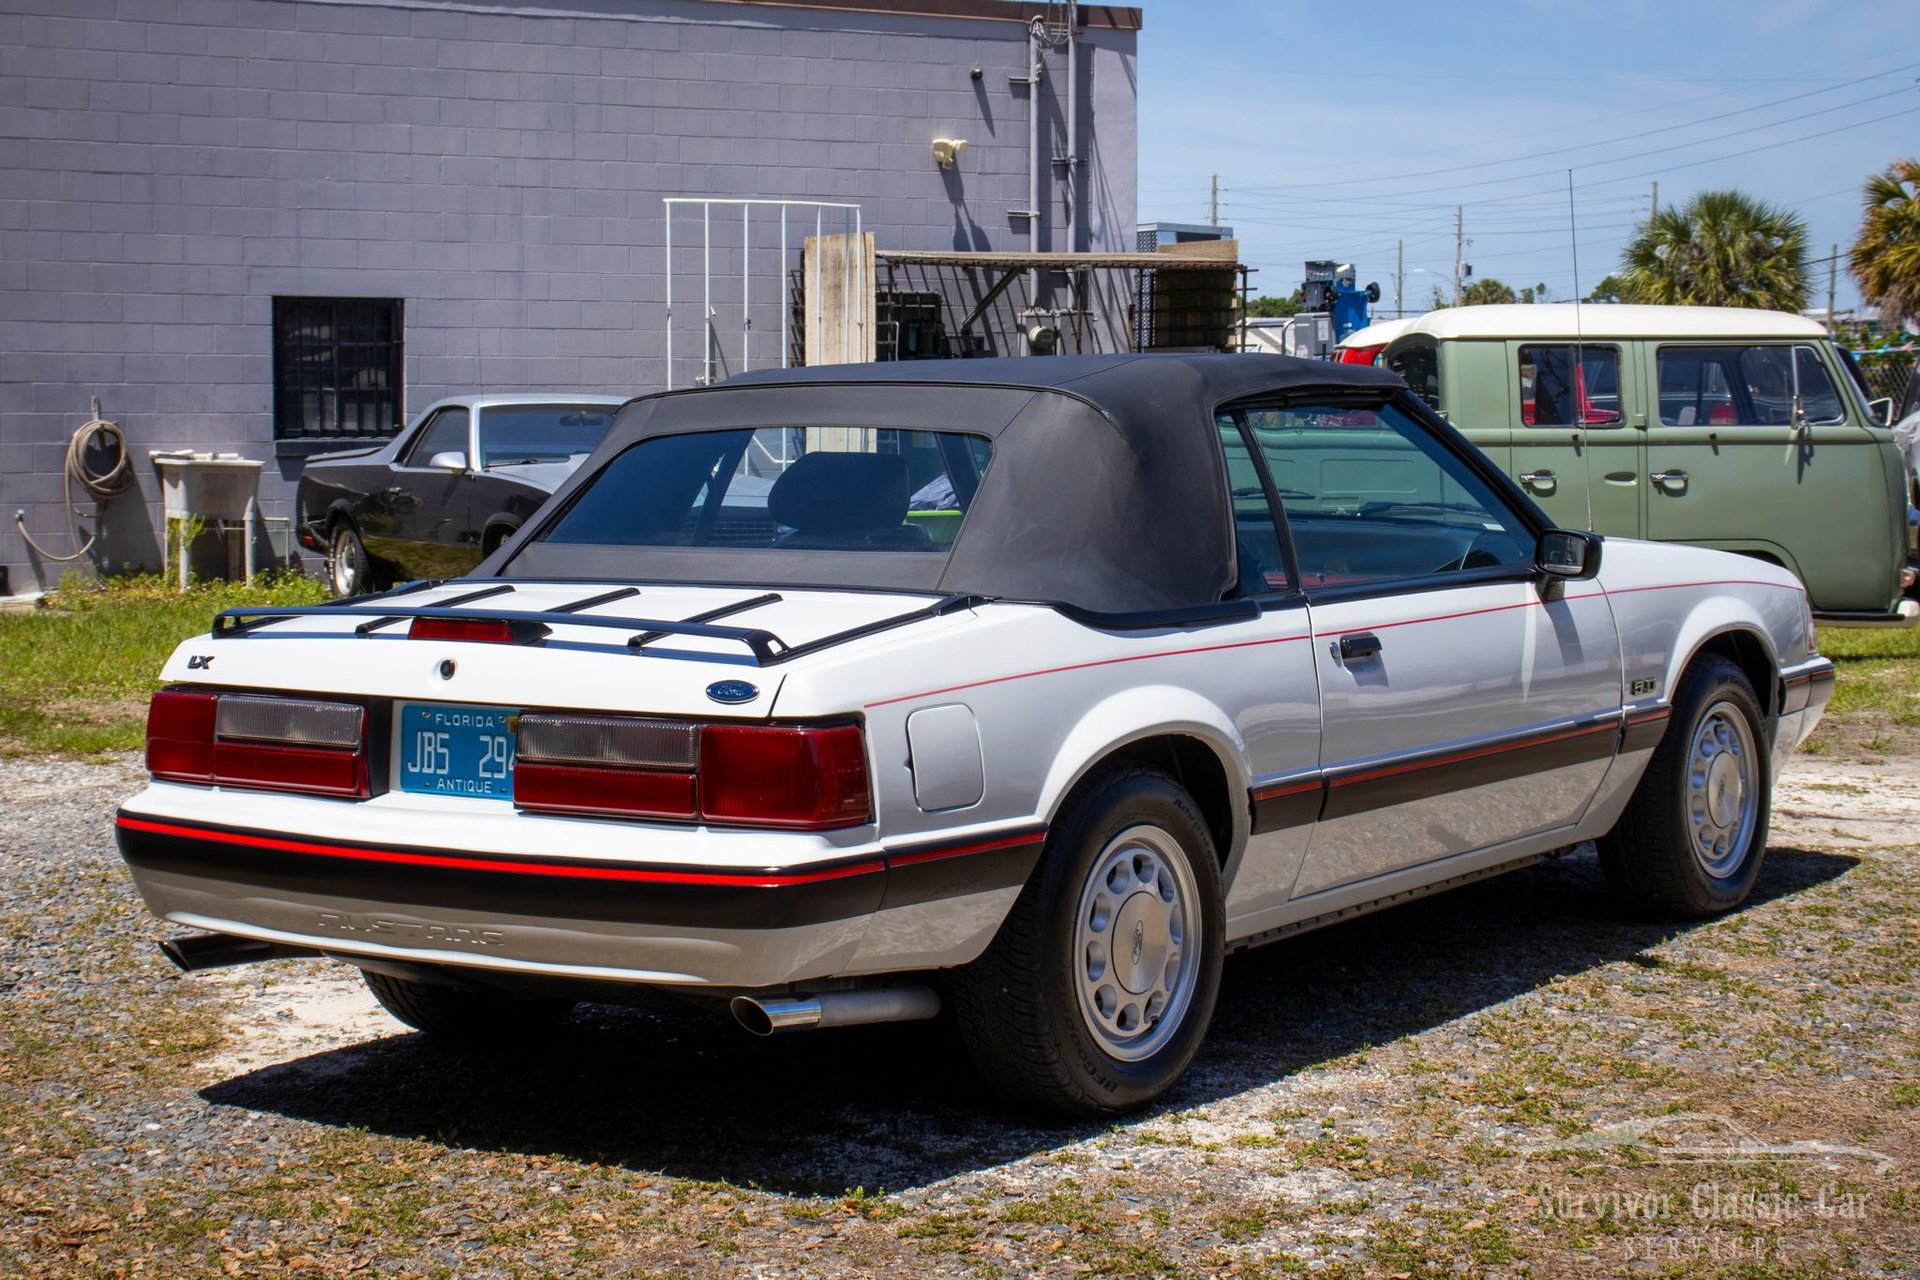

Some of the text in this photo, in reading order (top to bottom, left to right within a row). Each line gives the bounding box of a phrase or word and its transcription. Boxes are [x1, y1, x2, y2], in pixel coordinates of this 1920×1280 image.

[187, 655, 215, 670] LX
[435, 713, 494, 728] FLORIDA
[436, 778, 492, 794] ANTIQUE
